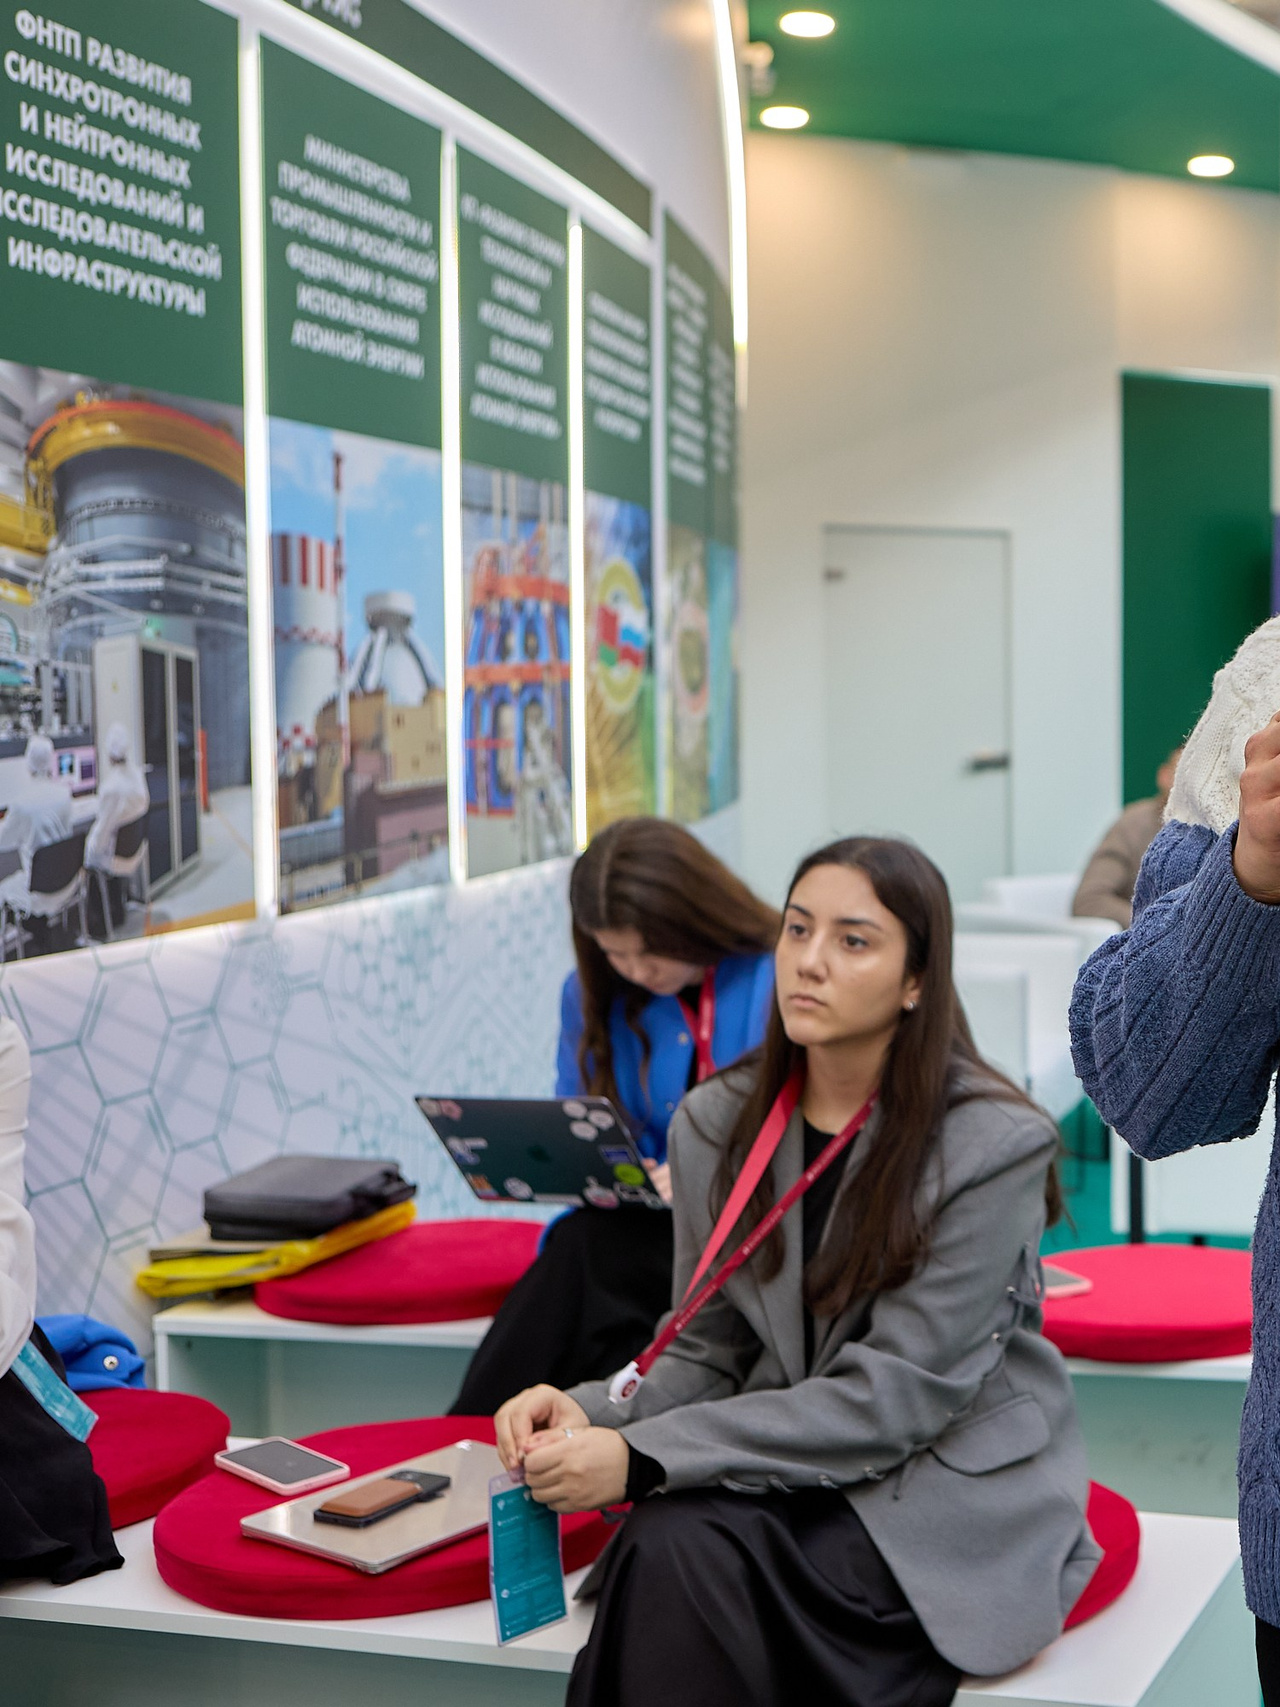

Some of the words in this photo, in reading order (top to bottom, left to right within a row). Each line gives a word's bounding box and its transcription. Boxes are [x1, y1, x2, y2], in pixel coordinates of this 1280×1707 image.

[4, 50, 202, 151] СИНХРОТРОННЫХ
[15, 9, 82, 61] ФНТП
[87, 36, 192, 106] РАЗВИТИЯ
[5, 142, 184, 228] ИССЛЕДОВАНИЙ
[186, 203, 204, 235] И
[19, 101, 38, 134] И
[44, 109, 192, 190] НЕЙТРОННЫХ
[0, 186, 222, 281] ССЛЕДОВАТЕЛЬСКОЙ
[8, 236, 206, 318] ИНФРАСТРУКТУРЫ
